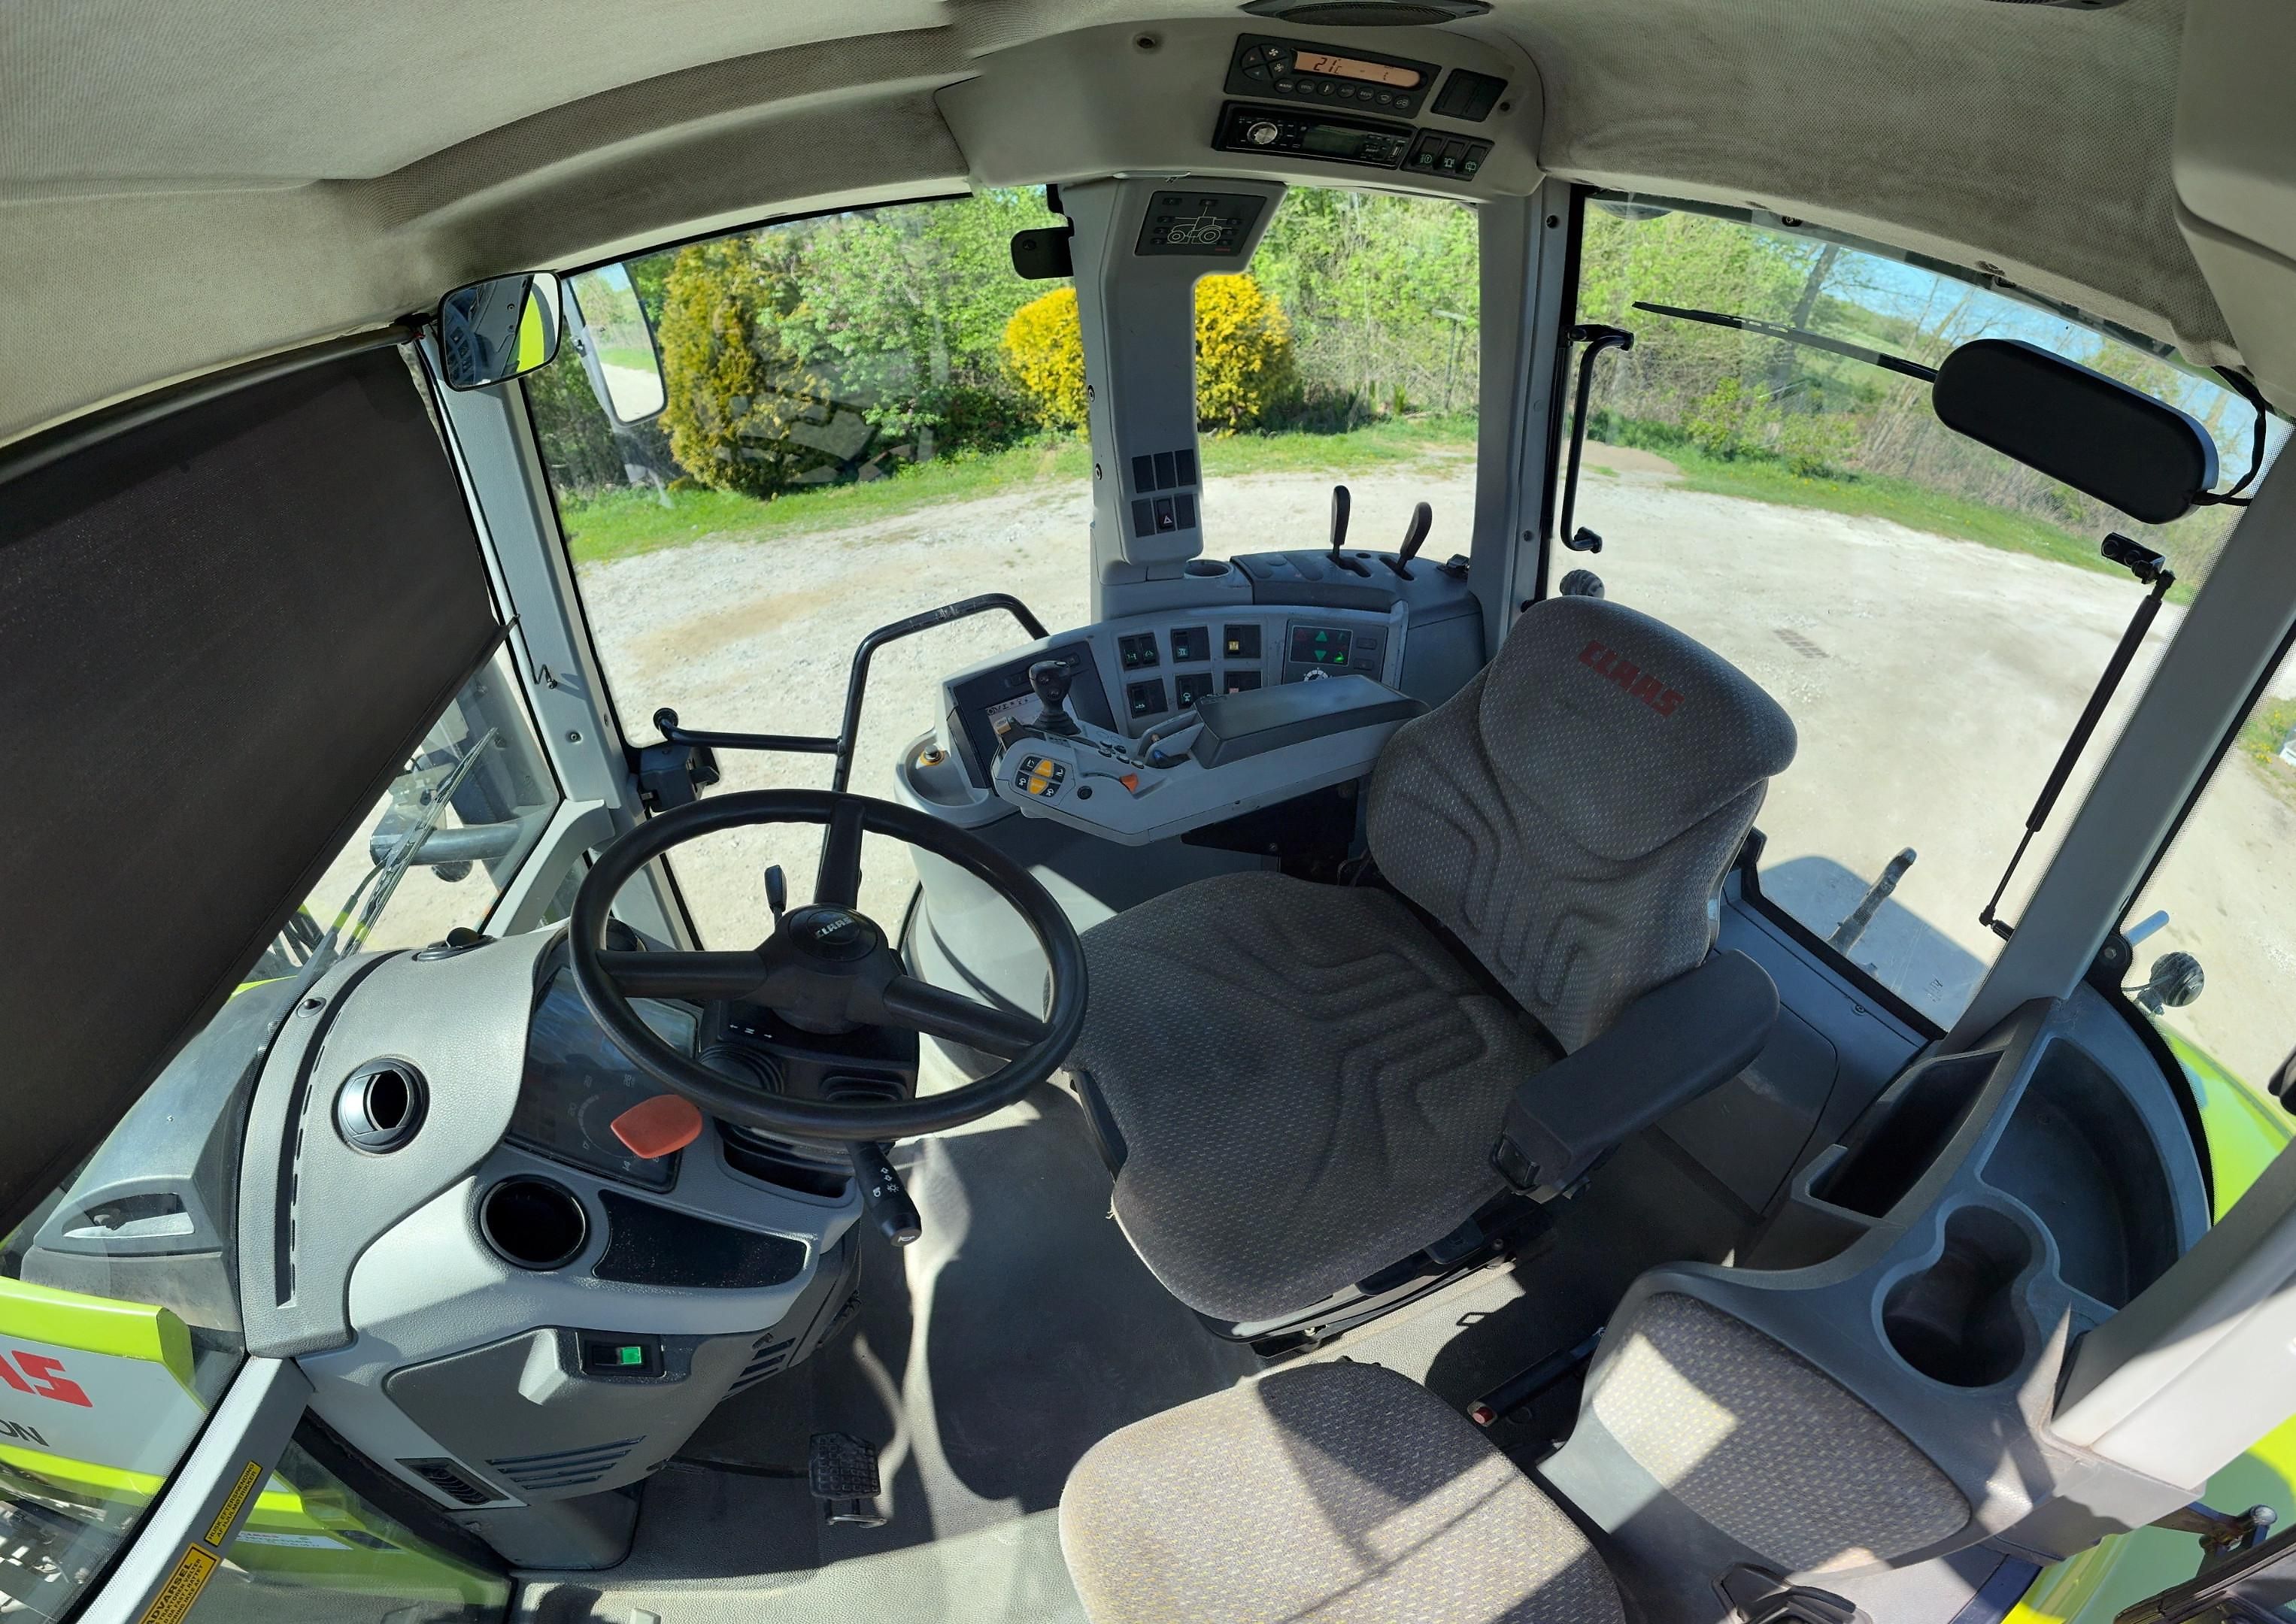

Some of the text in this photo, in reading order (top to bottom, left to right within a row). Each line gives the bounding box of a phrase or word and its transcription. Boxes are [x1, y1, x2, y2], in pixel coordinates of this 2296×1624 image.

[1578, 640, 1685, 717] CLAAS
[814, 917, 854, 938] CLAAS
[208, 1519, 223, 1541] HUSK
[216, 1527, 225, 1538] AF
[146, 1560, 193, 1624] ADVARSEL
[159, 1583, 186, 1621] TRAKTOREN
